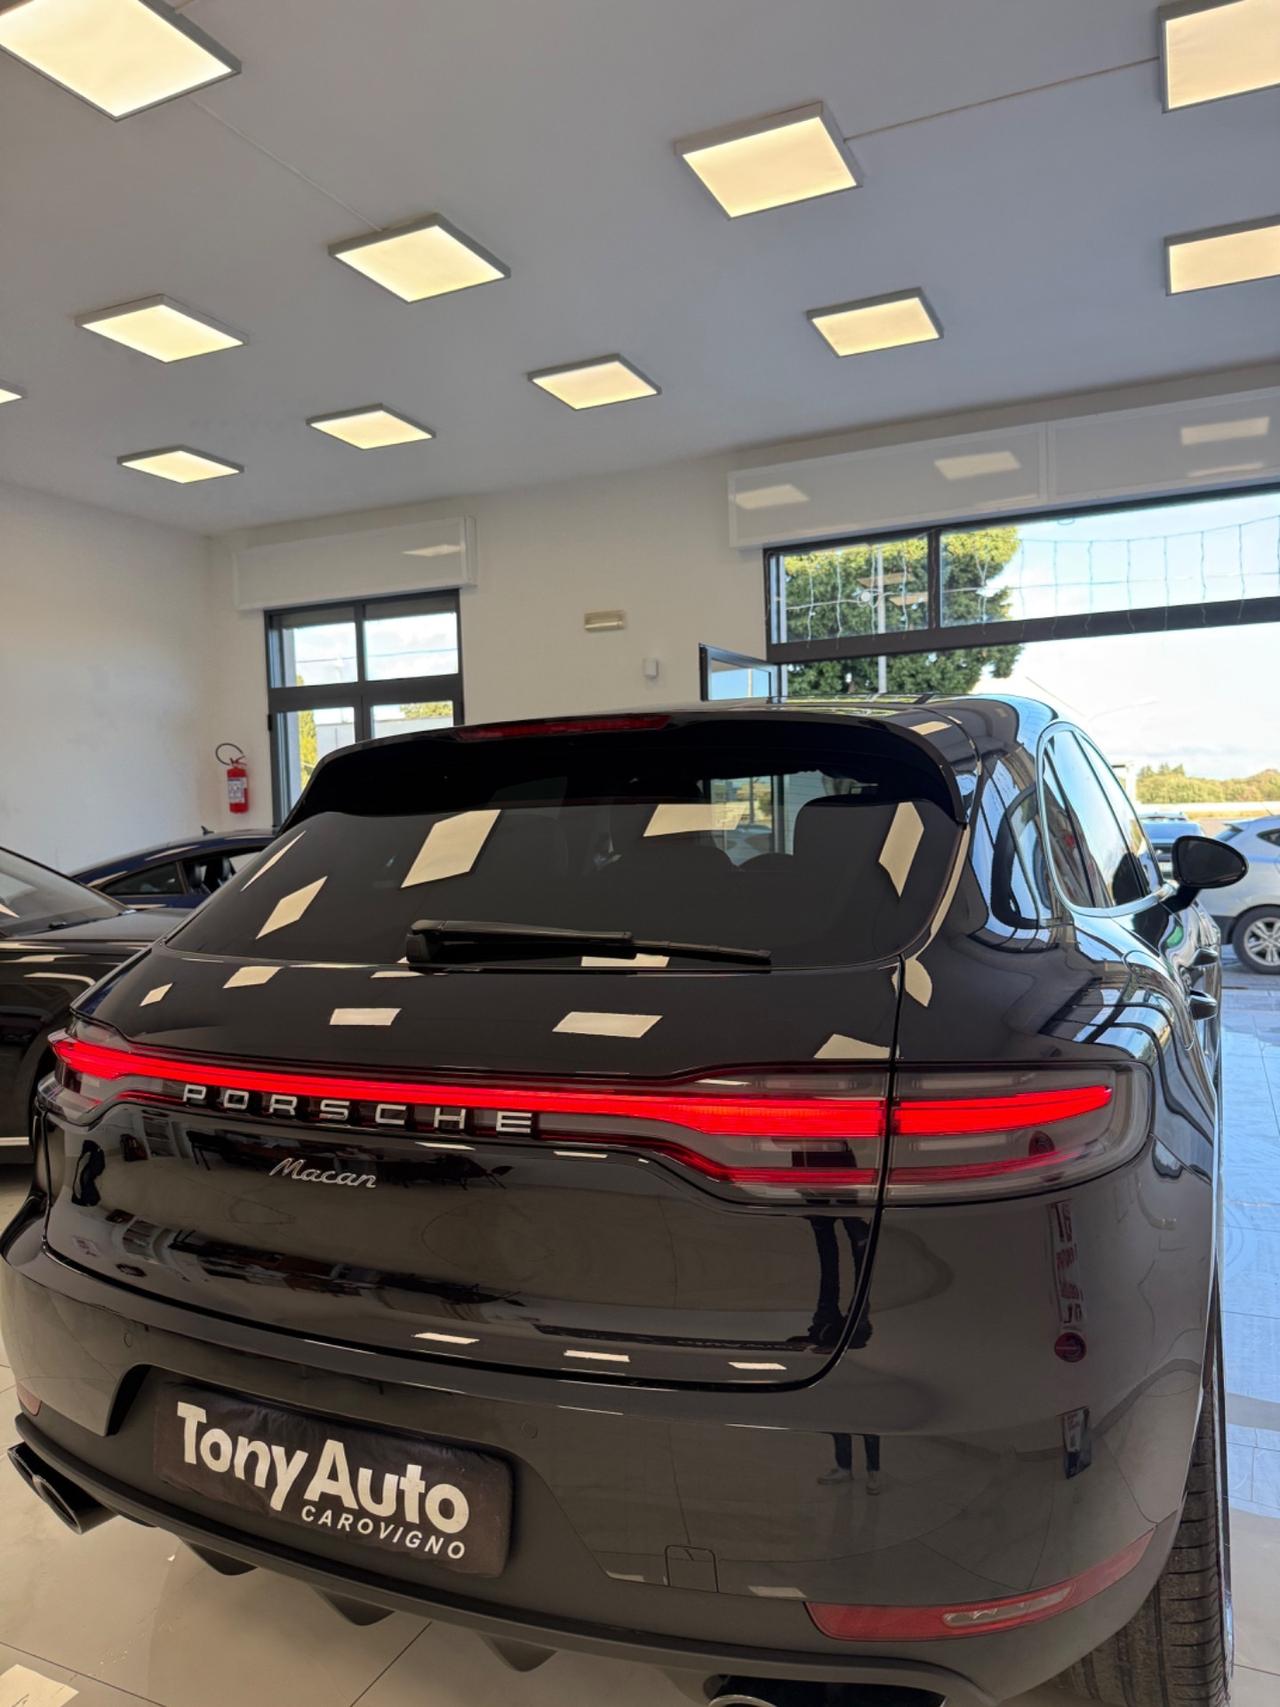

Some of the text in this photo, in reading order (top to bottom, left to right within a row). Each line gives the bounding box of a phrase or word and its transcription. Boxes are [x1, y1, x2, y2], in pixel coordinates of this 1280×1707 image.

[182, 1084, 533, 1134] PORSCHE
[269, 1156, 377, 1189] Macan
[301, 1505, 465, 1559] CAROVIGNO
